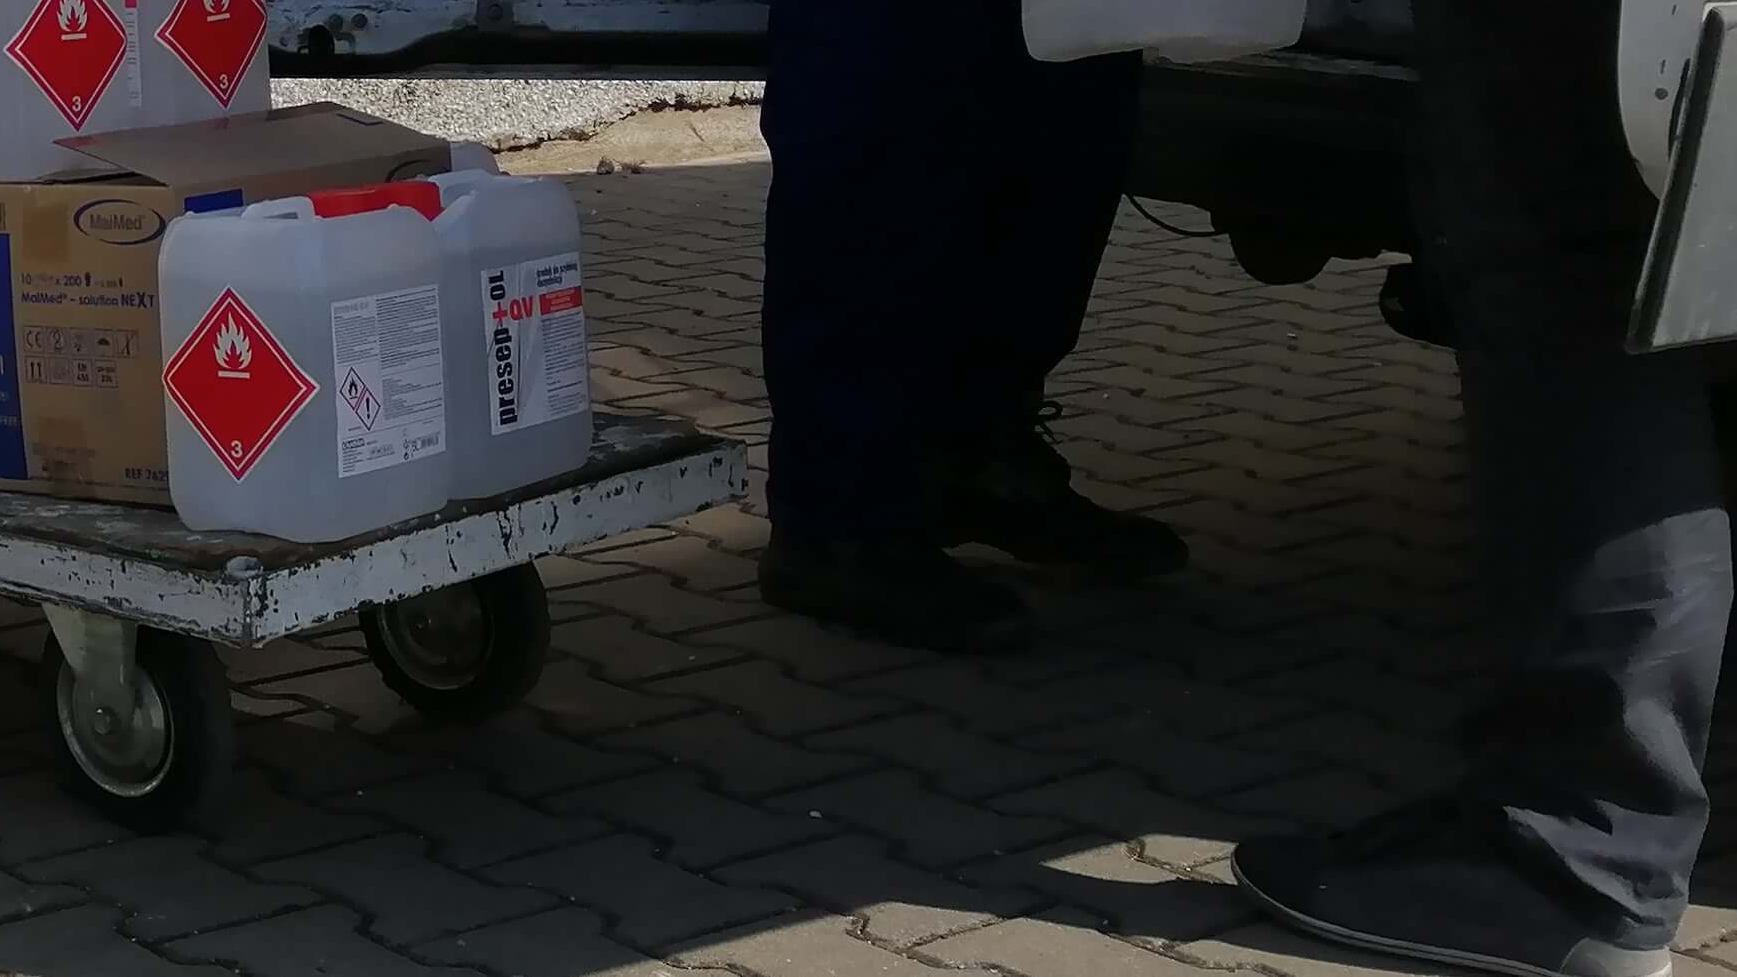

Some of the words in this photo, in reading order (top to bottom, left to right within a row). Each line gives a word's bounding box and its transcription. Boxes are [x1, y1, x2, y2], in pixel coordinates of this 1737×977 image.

[219, 73, 229, 89] 3
[71, 95, 82, 112] 3
[63, 275, 83, 288] 200
[230, 439, 243, 458] 3
